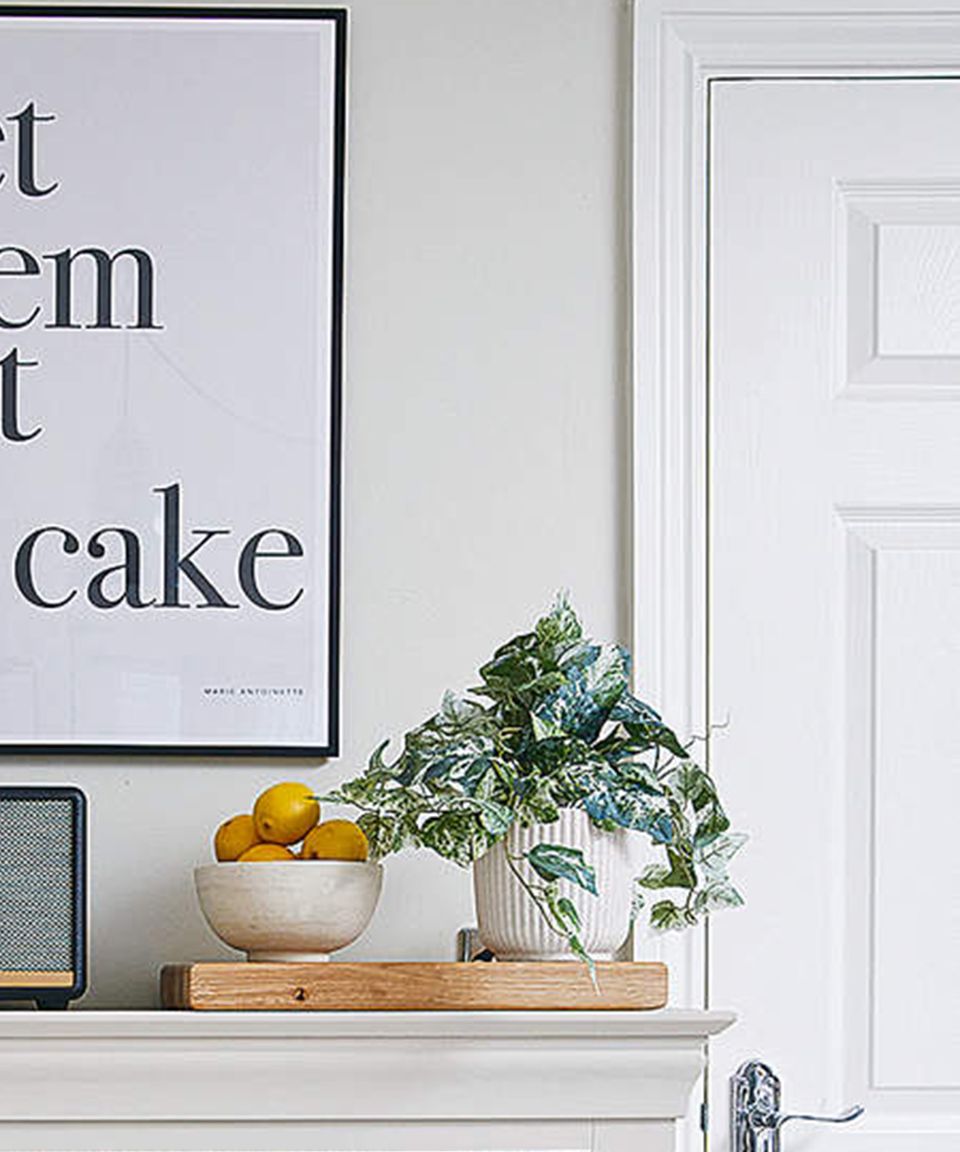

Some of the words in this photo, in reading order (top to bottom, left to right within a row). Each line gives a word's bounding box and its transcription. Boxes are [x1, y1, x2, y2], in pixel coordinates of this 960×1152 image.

[14, 483, 305, 611] cake
[203, 687, 235, 696] MARIE
[240, 687, 304, 696] ANTOINETTE
